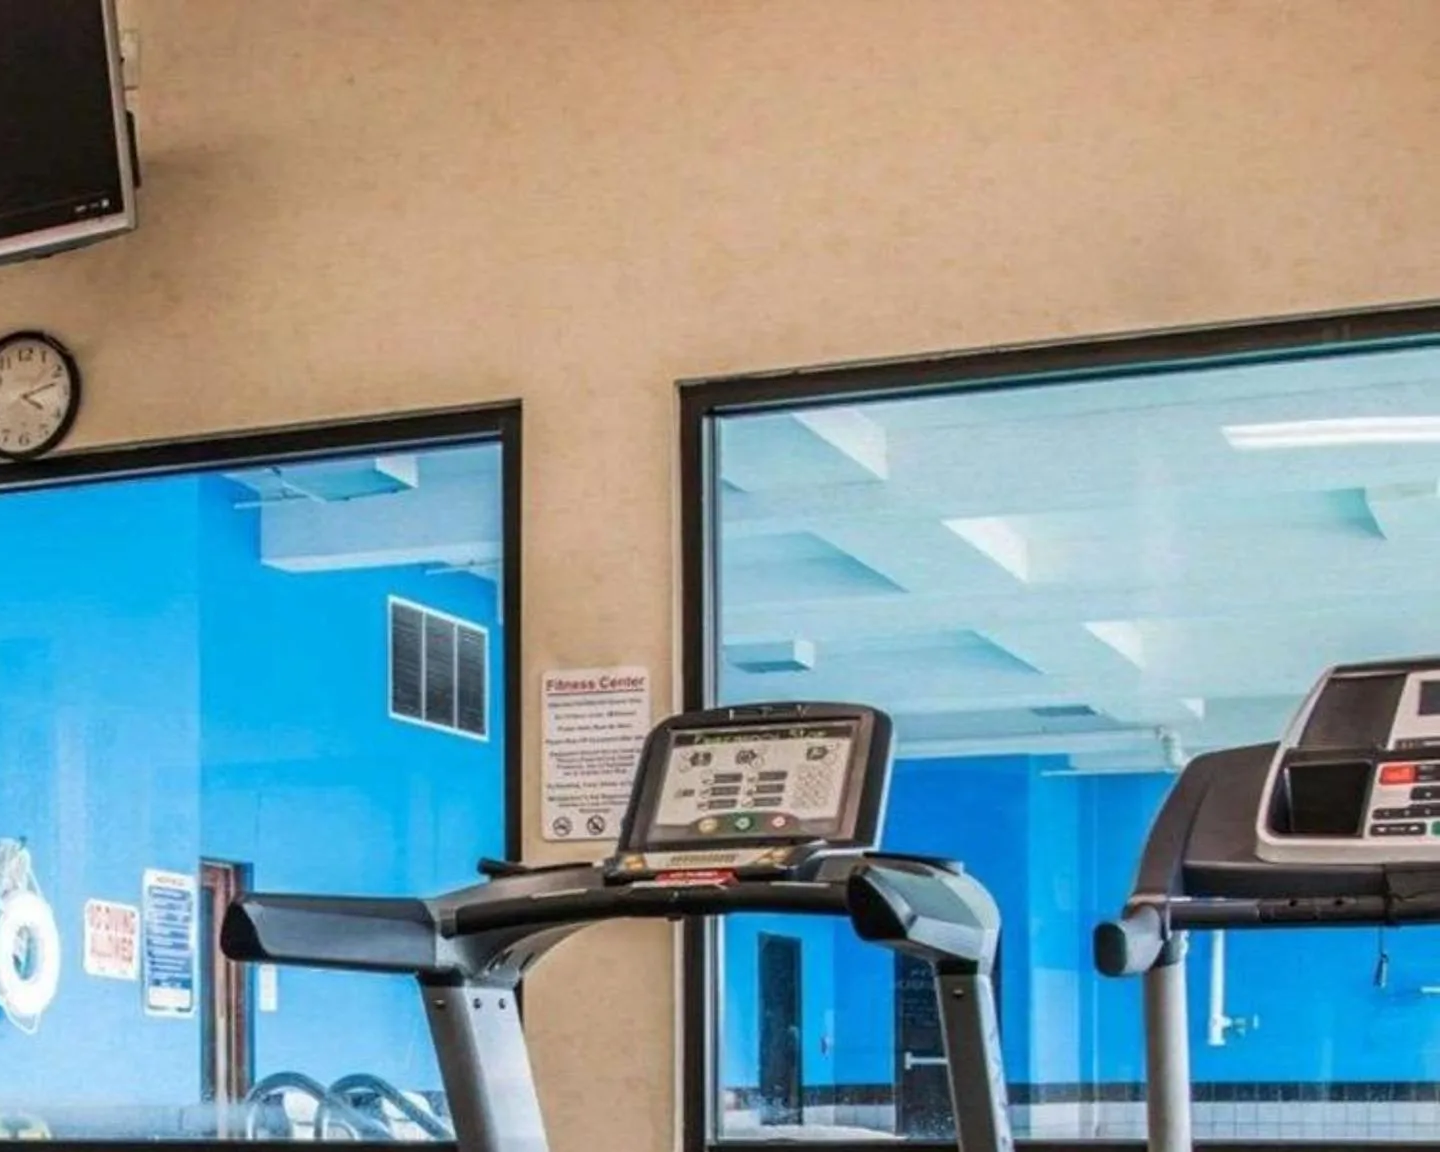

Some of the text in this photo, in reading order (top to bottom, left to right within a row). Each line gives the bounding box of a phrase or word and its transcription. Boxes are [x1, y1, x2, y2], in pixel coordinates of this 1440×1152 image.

[18, 347, 33, 362] 12
[546, 675, 645, 692] Fitness Center
